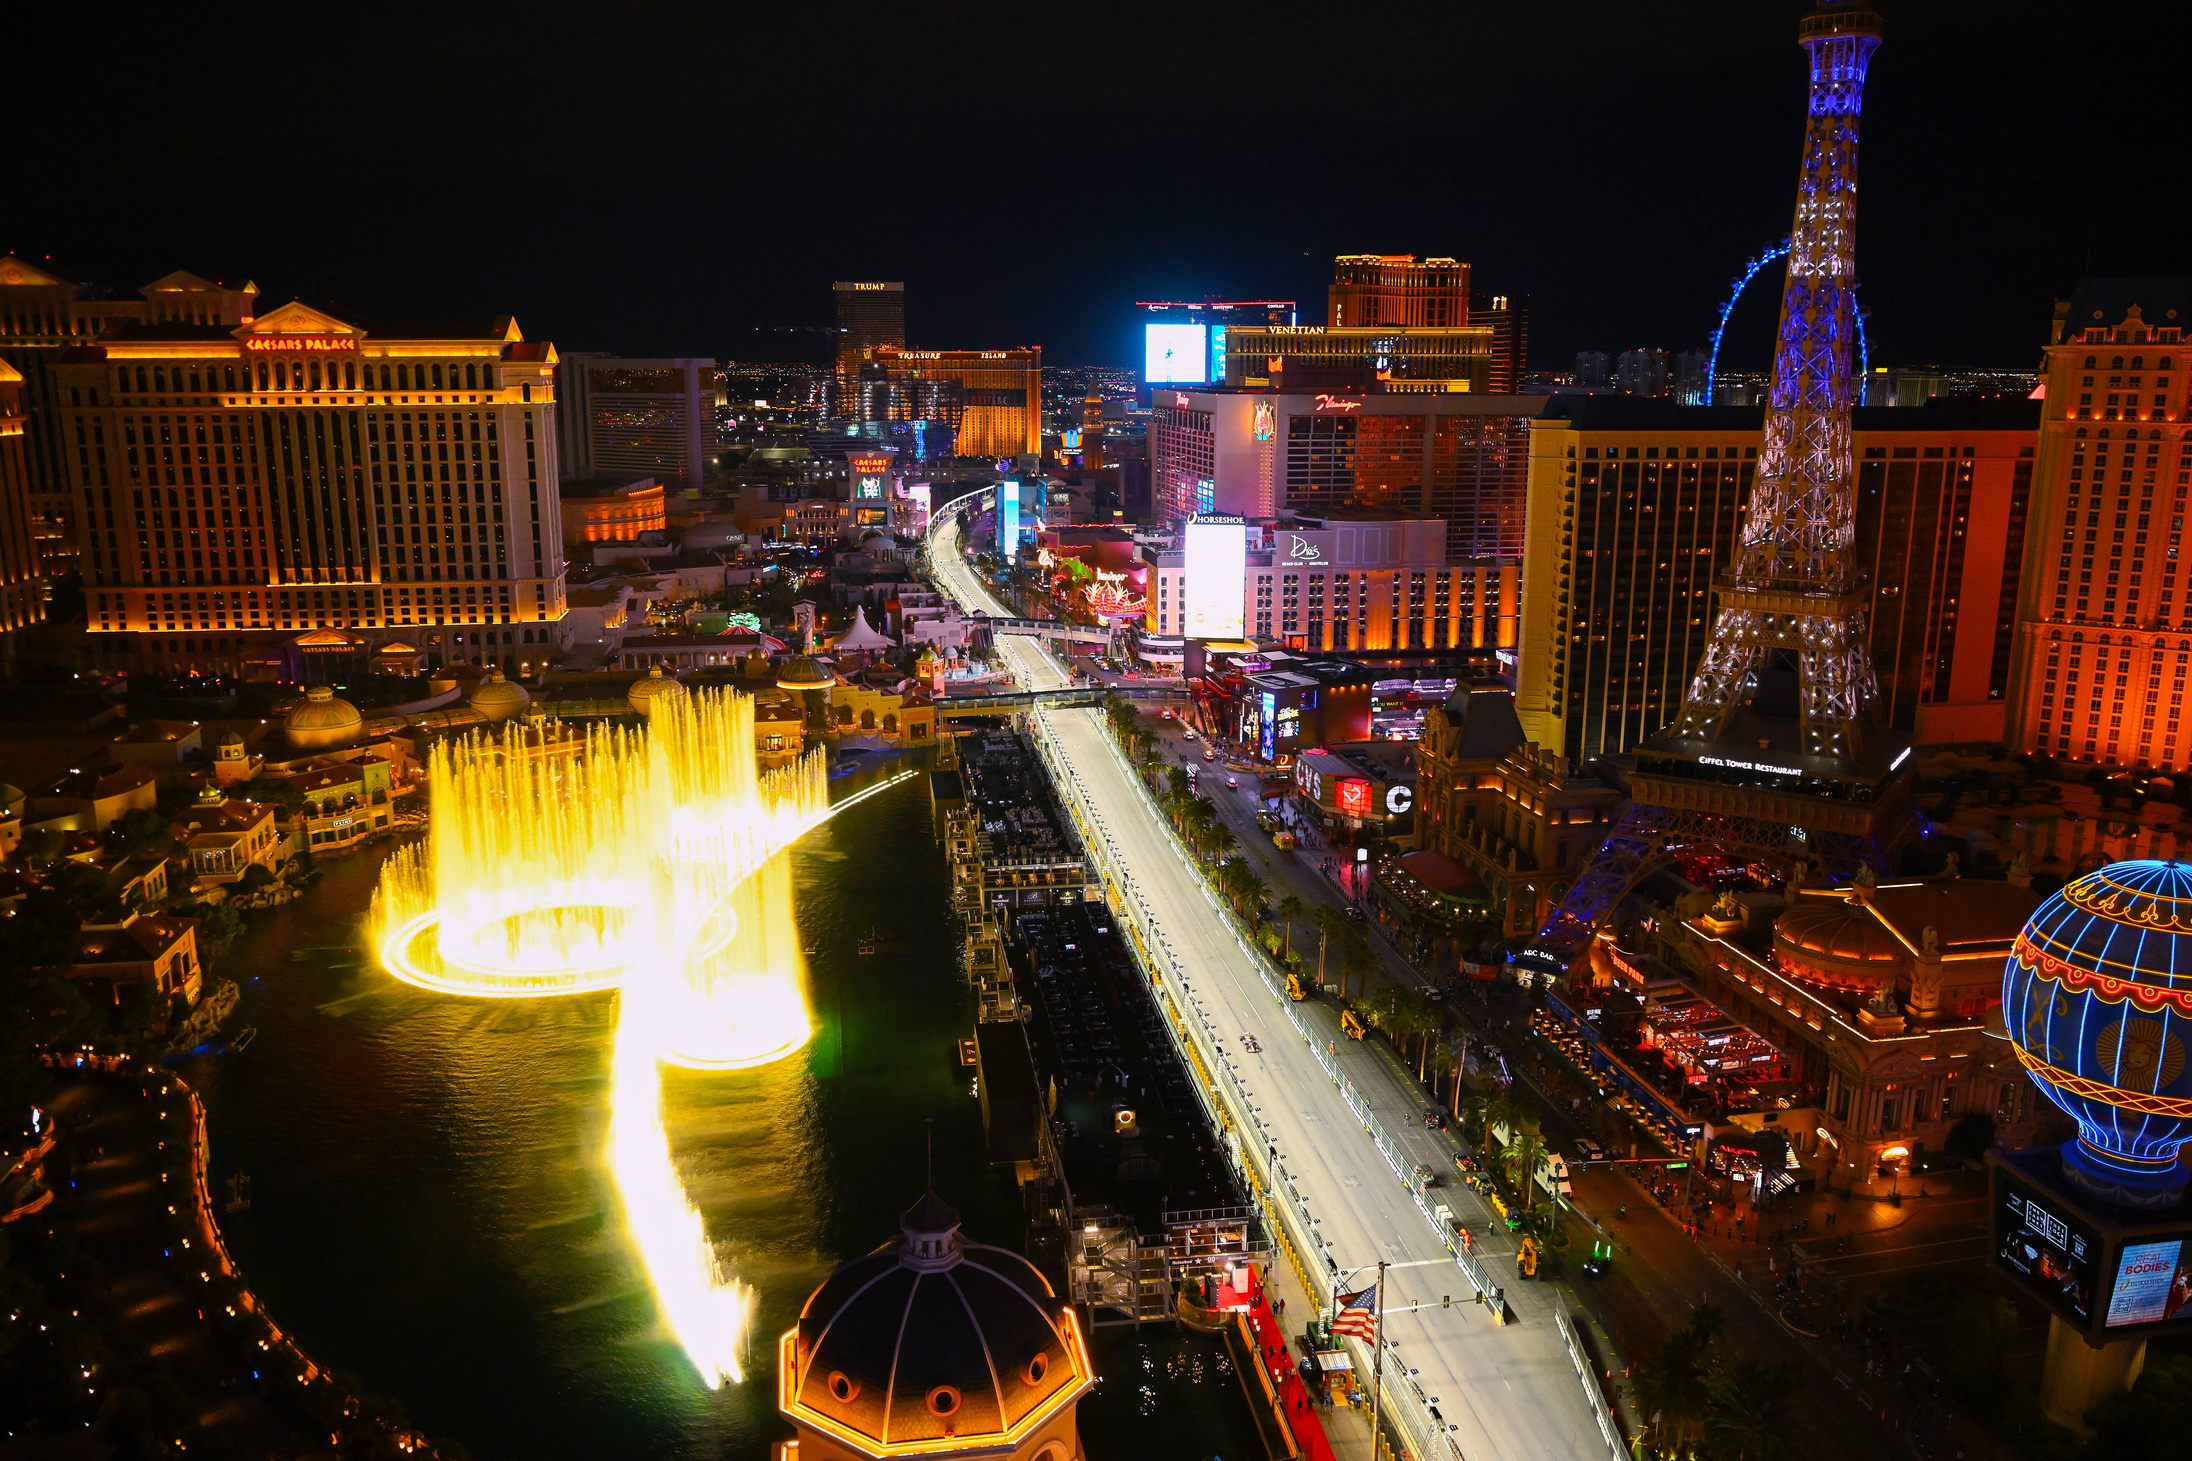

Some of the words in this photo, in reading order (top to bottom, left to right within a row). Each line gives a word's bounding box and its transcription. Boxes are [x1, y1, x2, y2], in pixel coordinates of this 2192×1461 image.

[854, 283, 885, 291] TRUMP
[1269, 326, 1325, 335] VENETIAN
[246, 339, 303, 351] CAESARS
[305, 339, 355, 350] PALACE
[898, 352, 941, 360] TREASURE
[1315, 394, 1361, 411] Flamingo
[1198, 516, 1245, 524] HORSESHOE
[1699, 756, 1724, 766] EIFFEL
[1725, 759, 1753, 770] TOWER
[1755, 763, 1802, 776] RESTAURANT
[1296, 759, 1321, 800] CVS
[1386, 785, 1412, 813] C
[1523, 949, 1538, 957] ARC
[1540, 951, 1554, 961] BAR
[1613, 955, 1628, 974] BEER
[1628, 966, 1645, 985] PARK
[2135, 1252, 2163, 1264] REAL
[2125, 1261, 2170, 1275] BODIES
